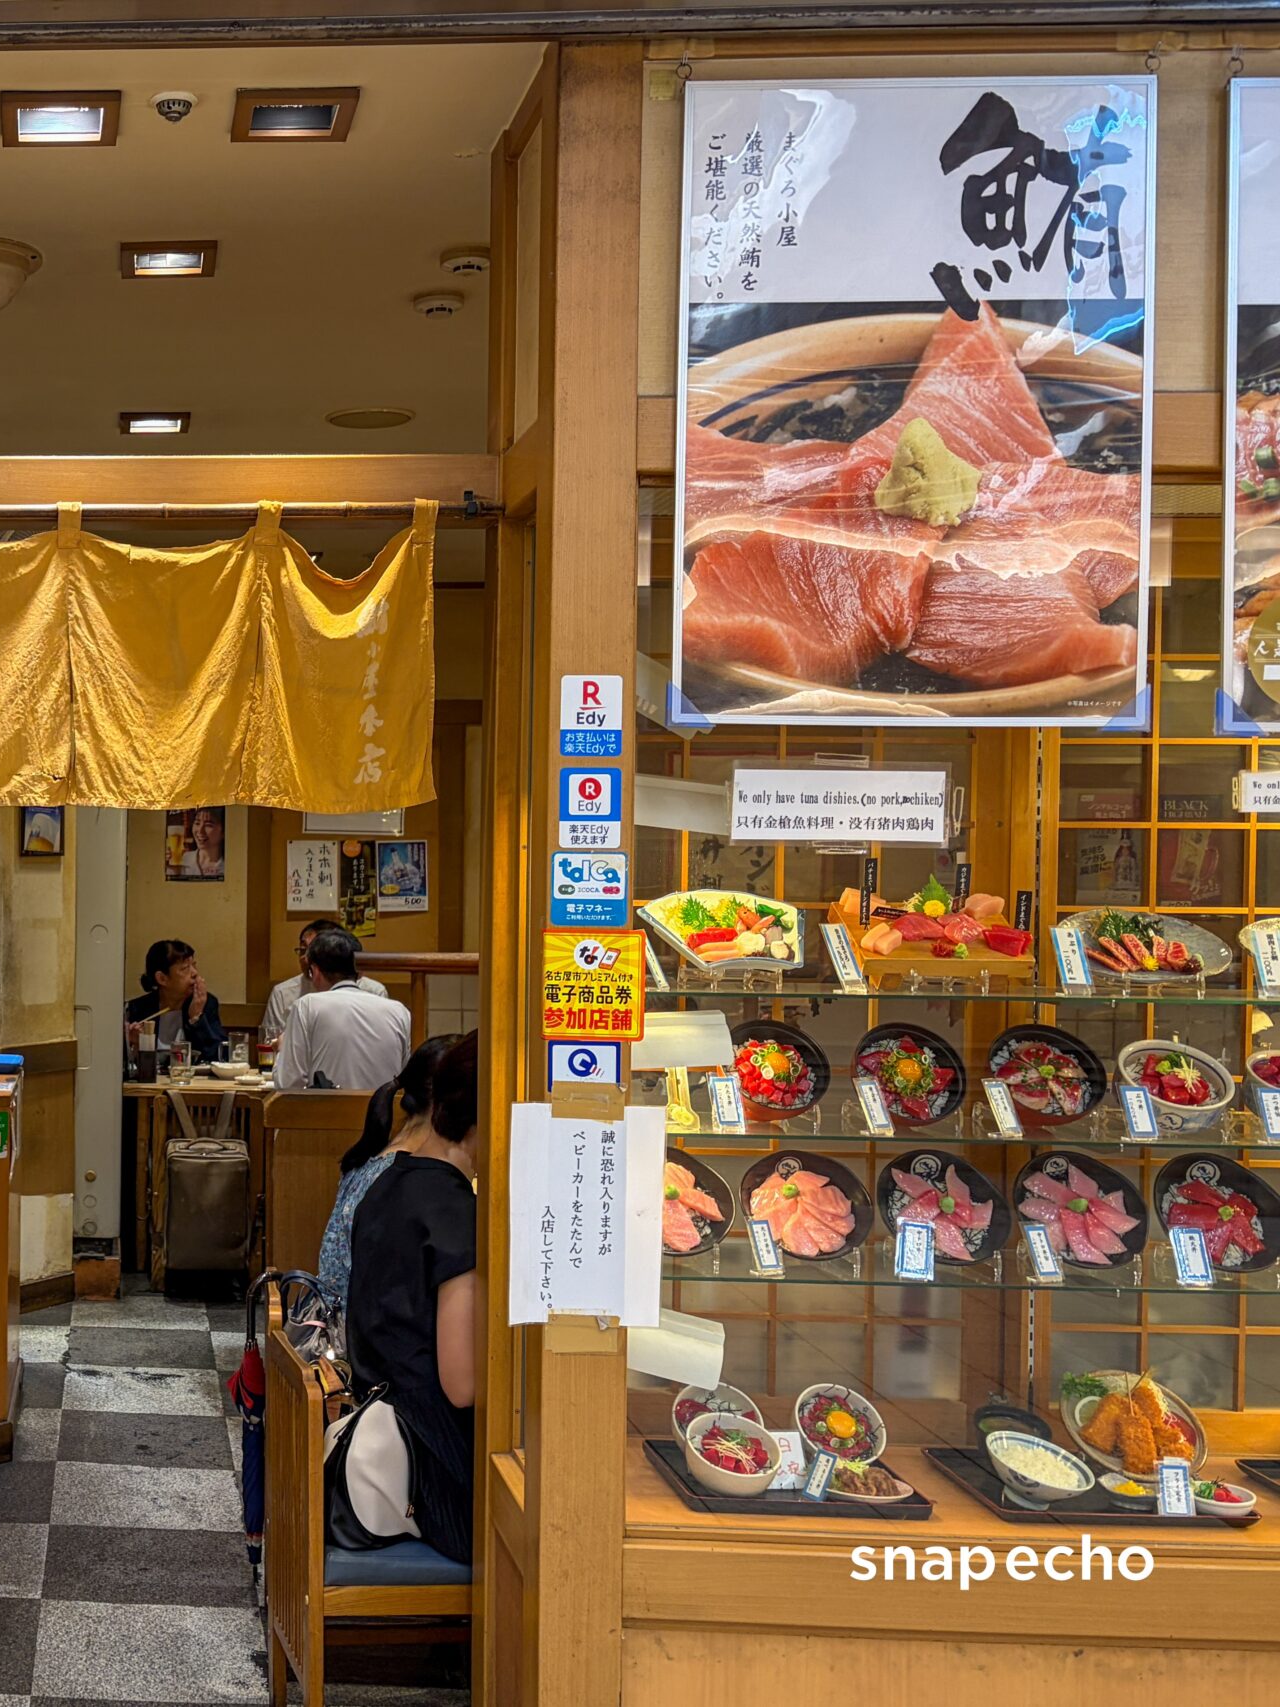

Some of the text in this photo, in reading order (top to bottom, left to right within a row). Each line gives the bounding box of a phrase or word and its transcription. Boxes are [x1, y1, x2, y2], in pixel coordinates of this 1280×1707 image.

[775, 131, 799, 247] まぐろ小屋
[738, 131, 764, 291] 厳選の天然鮪を
[929, 91, 1133, 321] 鮪
[704, 134, 728, 299] ご堪能ください。
[582, 680, 602, 706] R
[576, 711, 607, 727] Edy
[565, 732, 616, 743] お支払いは
[564, 743, 616, 755] 楽天Edyで
[584, 782, 596, 796] R
[738, 790, 748, 803] We
[752, 790, 771, 806] only
[775, 791, 796, 805] have
[800, 791, 819, 805] tuna
[577, 800, 602, 814] Edy
[569, 824, 610, 836] 楽天Edy
[570, 835, 609, 845] 使えます
[566, 903, 613, 913] 電子マネー
[544, 970, 633, 983] 名古屋市プレミアム付き
[544, 983, 633, 1005] 電子商品券
[543, 1007, 633, 1031] 参加店舗
[569, 1130, 587, 1269] ベビーカーをたたんで
[598, 1130, 616, 1256] 誠に恐れ入りますが
[540, 1205, 556, 1309] 入店して下さい。
